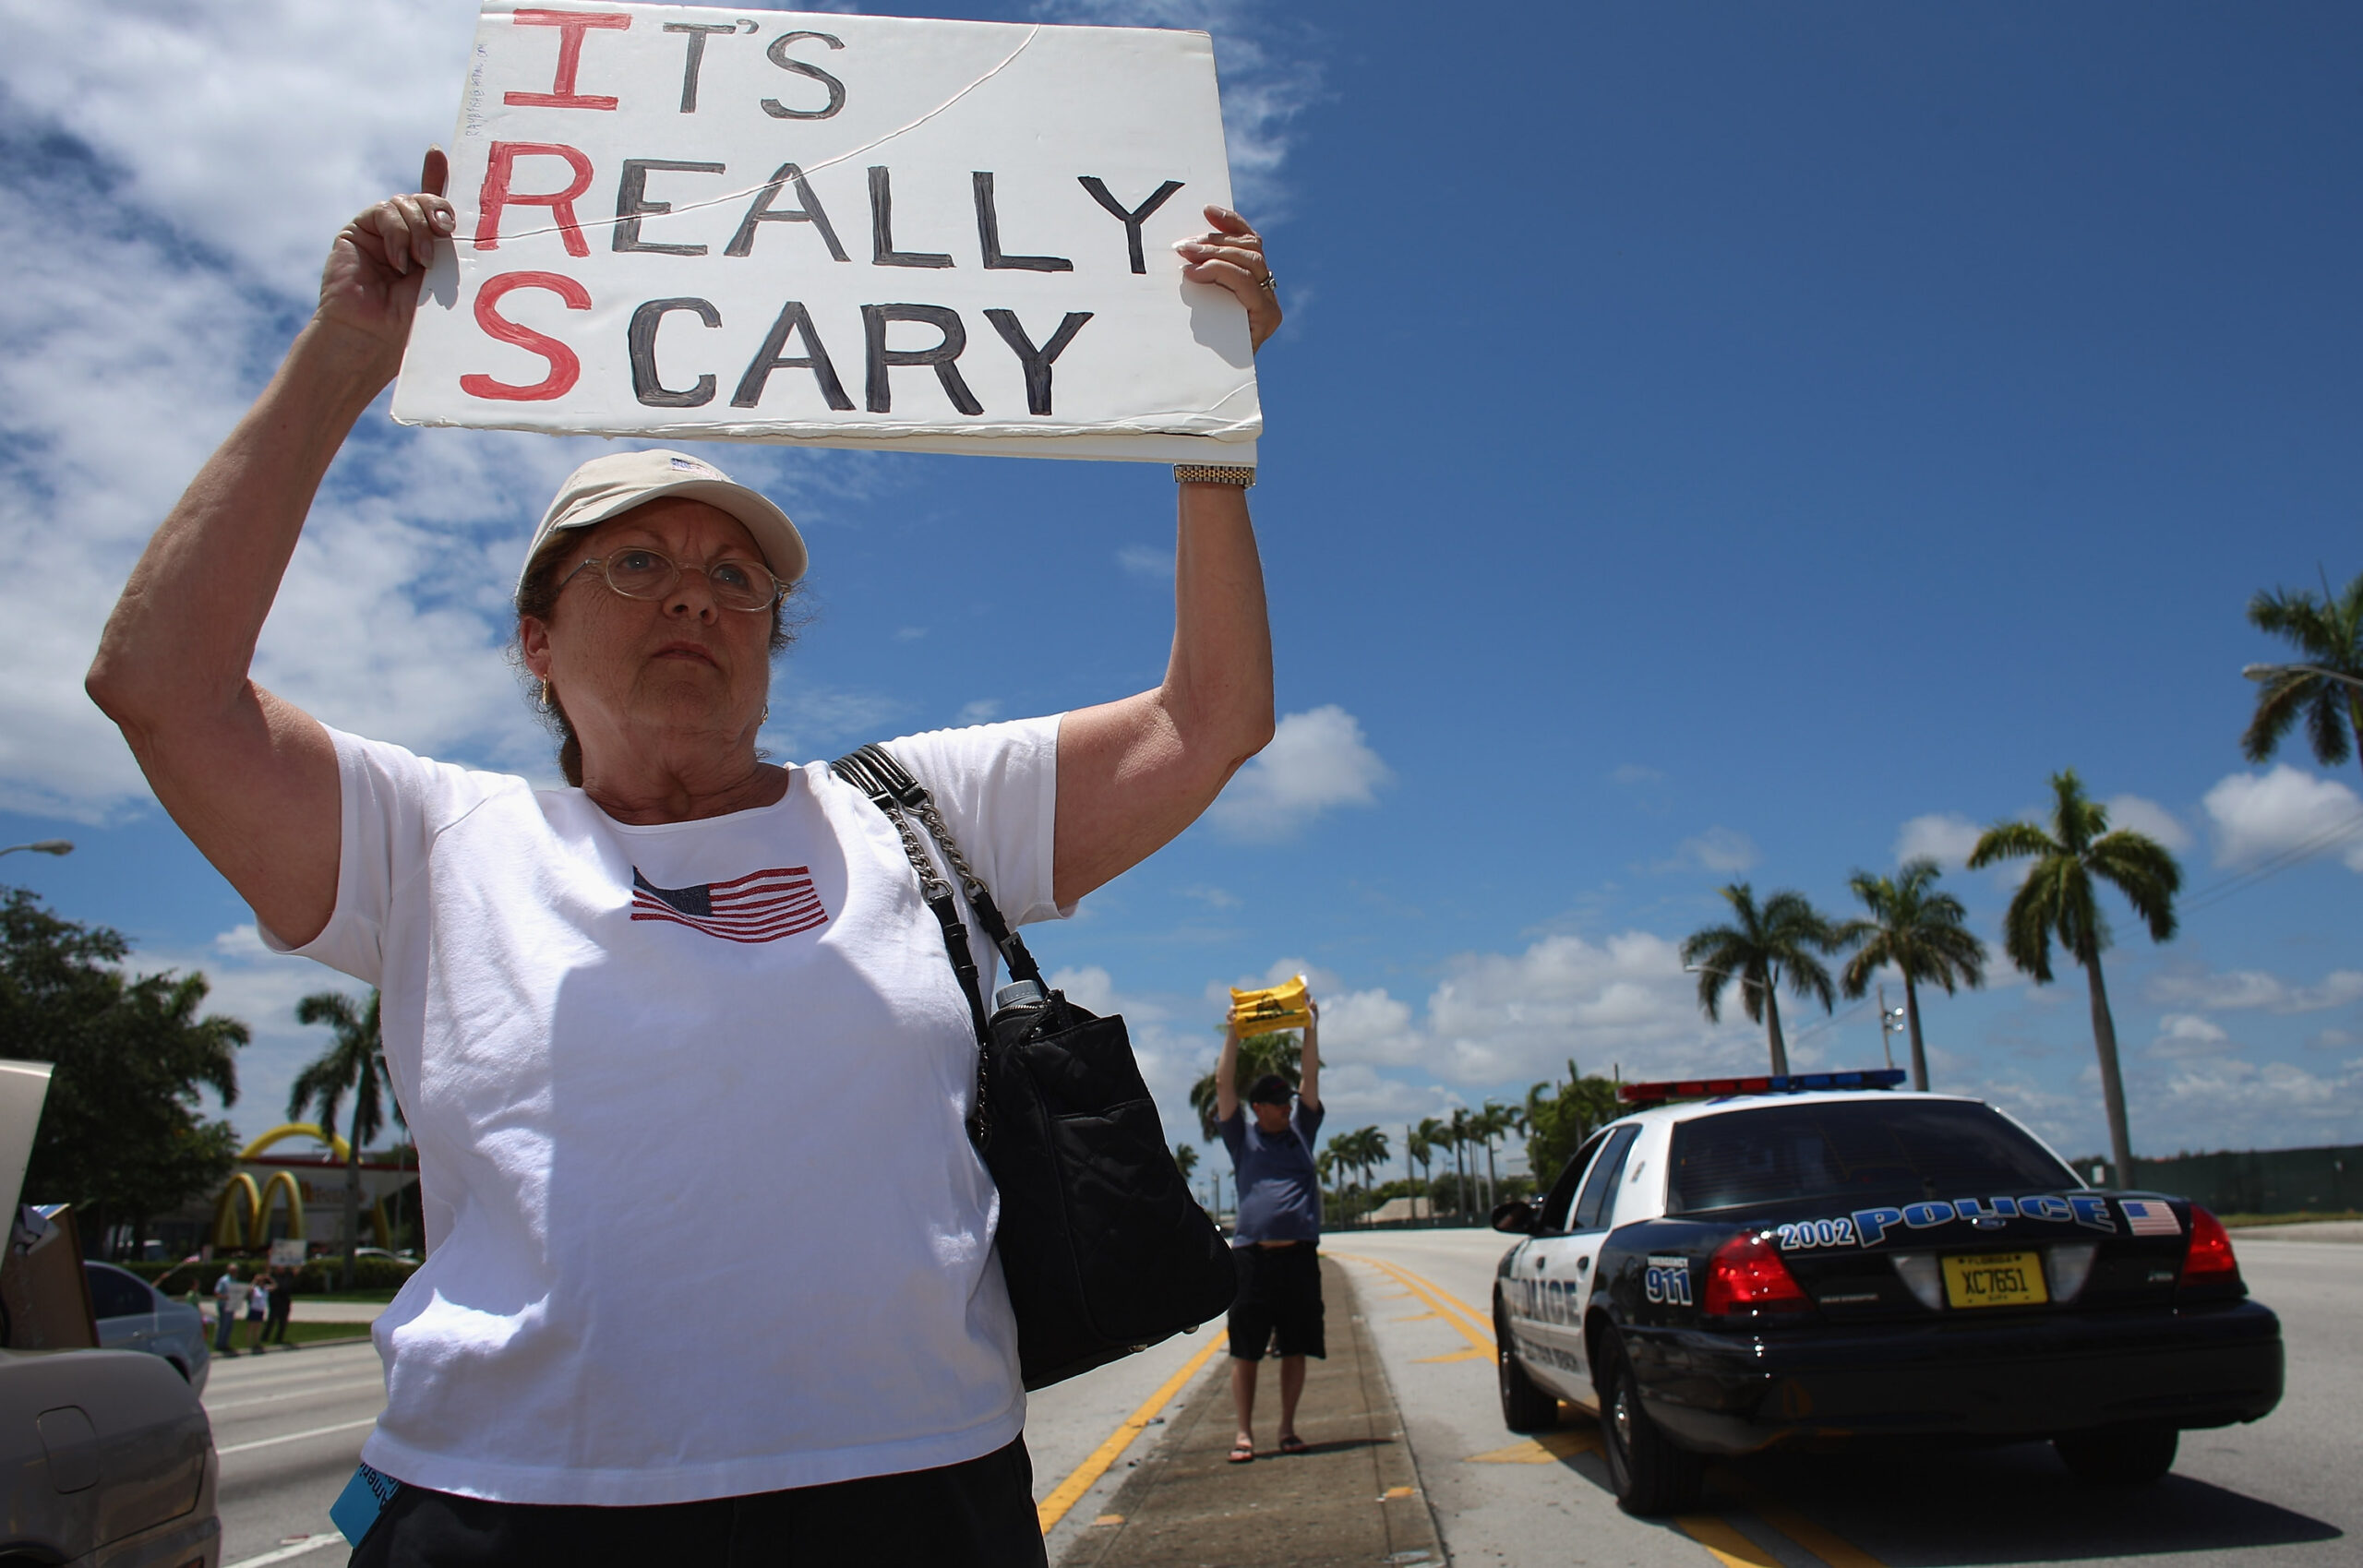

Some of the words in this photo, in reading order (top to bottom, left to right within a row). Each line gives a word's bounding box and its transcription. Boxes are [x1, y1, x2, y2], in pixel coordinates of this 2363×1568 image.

[474, 139, 1186, 276] REALLY
[460, 270, 1095, 418] SCARY
[1777, 1217, 1856, 1251] 2002
[1851, 1195, 2117, 1249] POLICE
[1645, 1265, 1694, 1307] 911
[1961, 1267, 2029, 1295] XC7651
